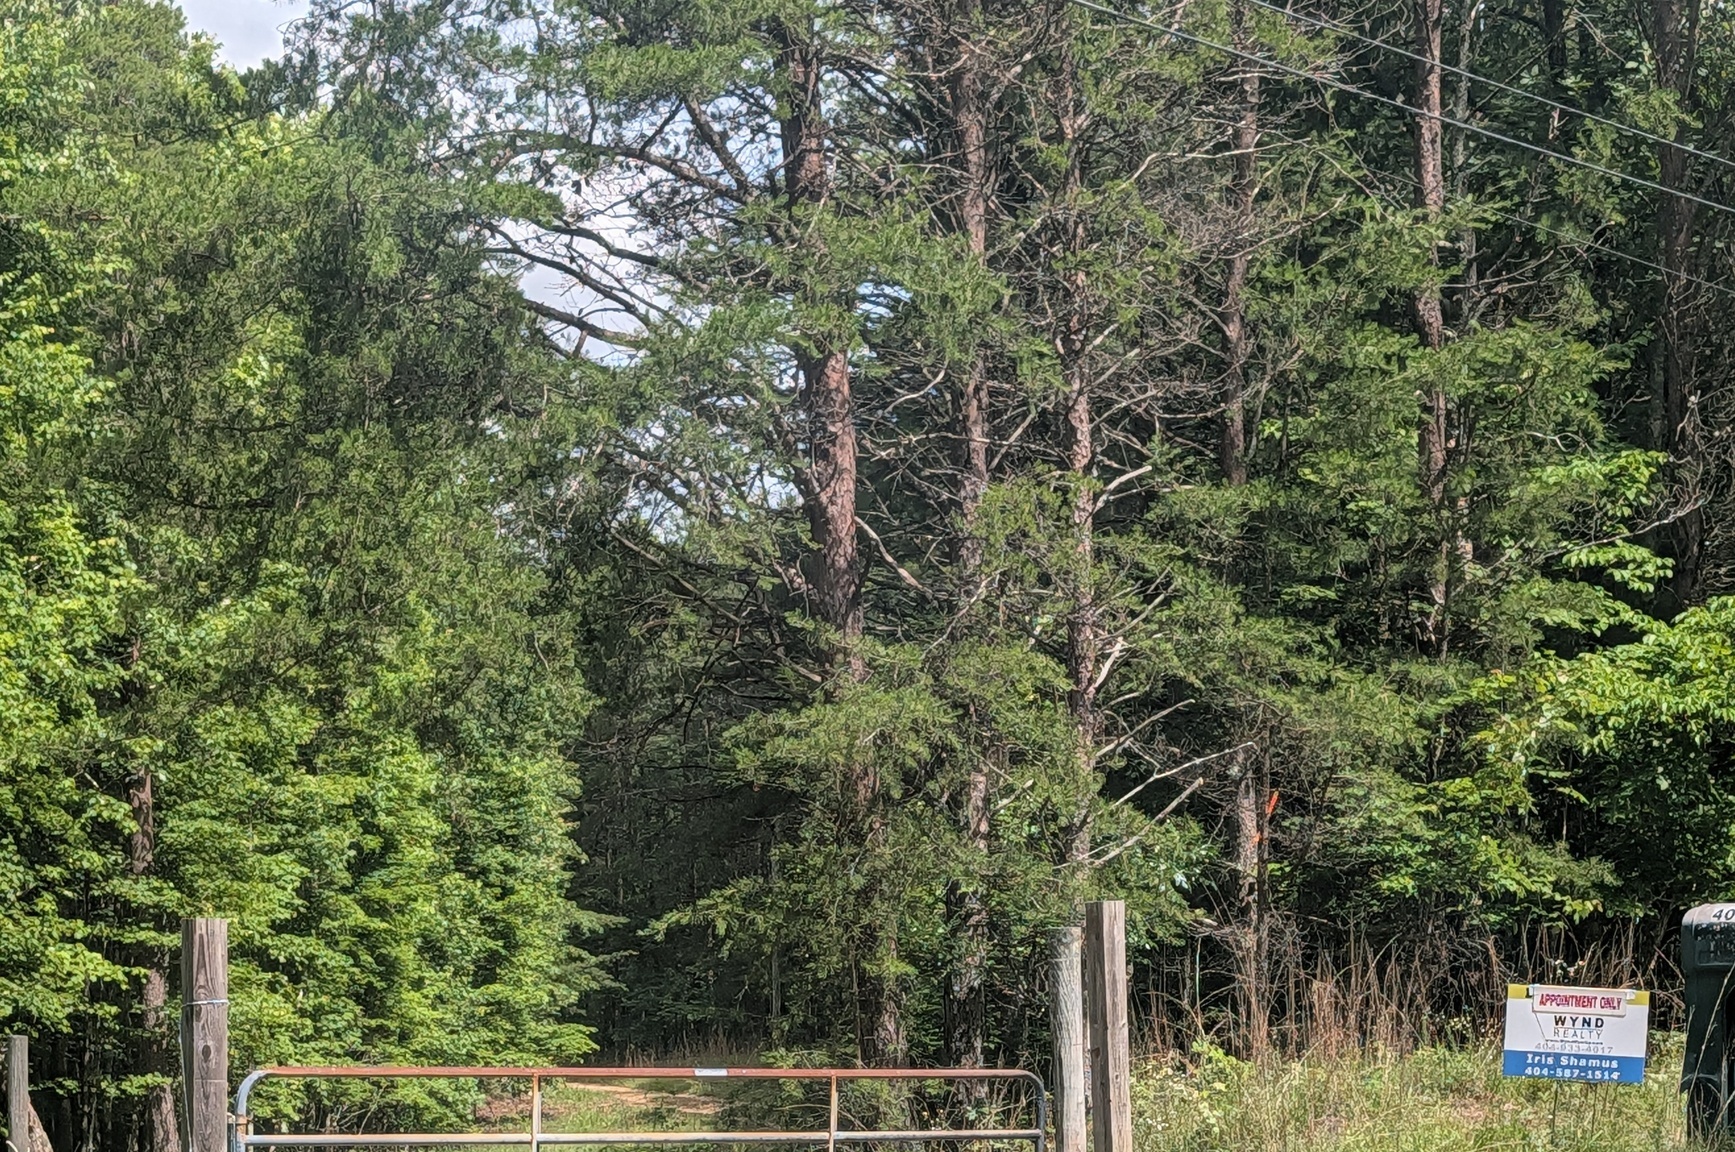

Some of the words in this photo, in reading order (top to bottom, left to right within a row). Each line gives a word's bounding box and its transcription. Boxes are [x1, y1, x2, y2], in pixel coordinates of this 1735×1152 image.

[1539, 993, 1598, 1008] APPOINTMENT
[1600, 996, 1622, 1010] ONLY
[1554, 1015, 1604, 1028] WYND
[1553, 1028, 1604, 1039] REALTY
[1526, 1053, 1555, 1065] Iris
[1560, 1055, 1619, 1068] Shamus
